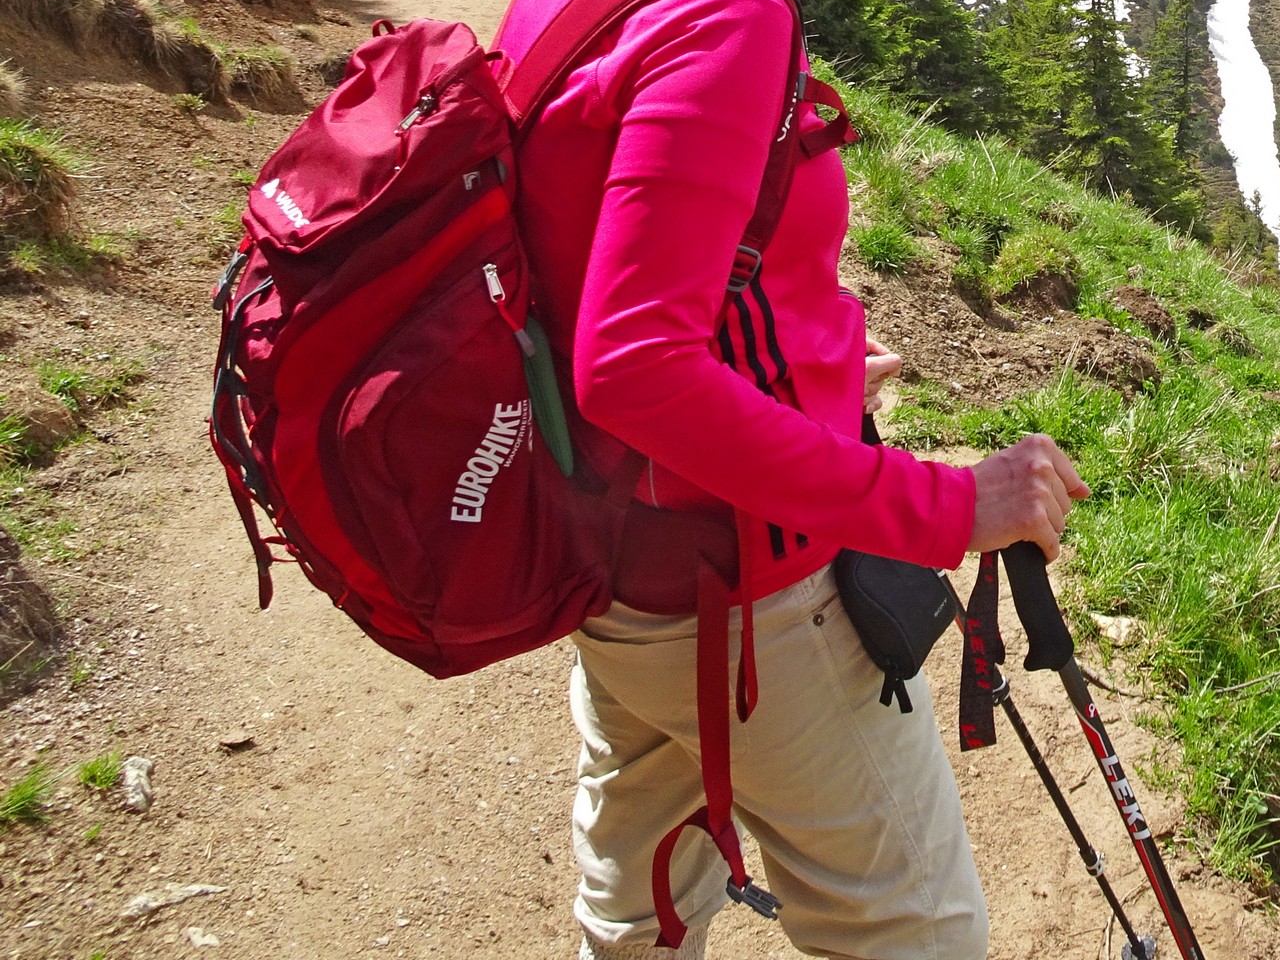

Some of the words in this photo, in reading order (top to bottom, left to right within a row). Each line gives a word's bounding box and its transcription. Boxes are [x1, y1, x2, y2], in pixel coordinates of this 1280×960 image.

[276, 190, 310, 228] VAUDE
[450, 401, 522, 523] EUROHIKE
[966, 618, 991, 689] LEKI
[1101, 754, 1151, 840] LEKI
